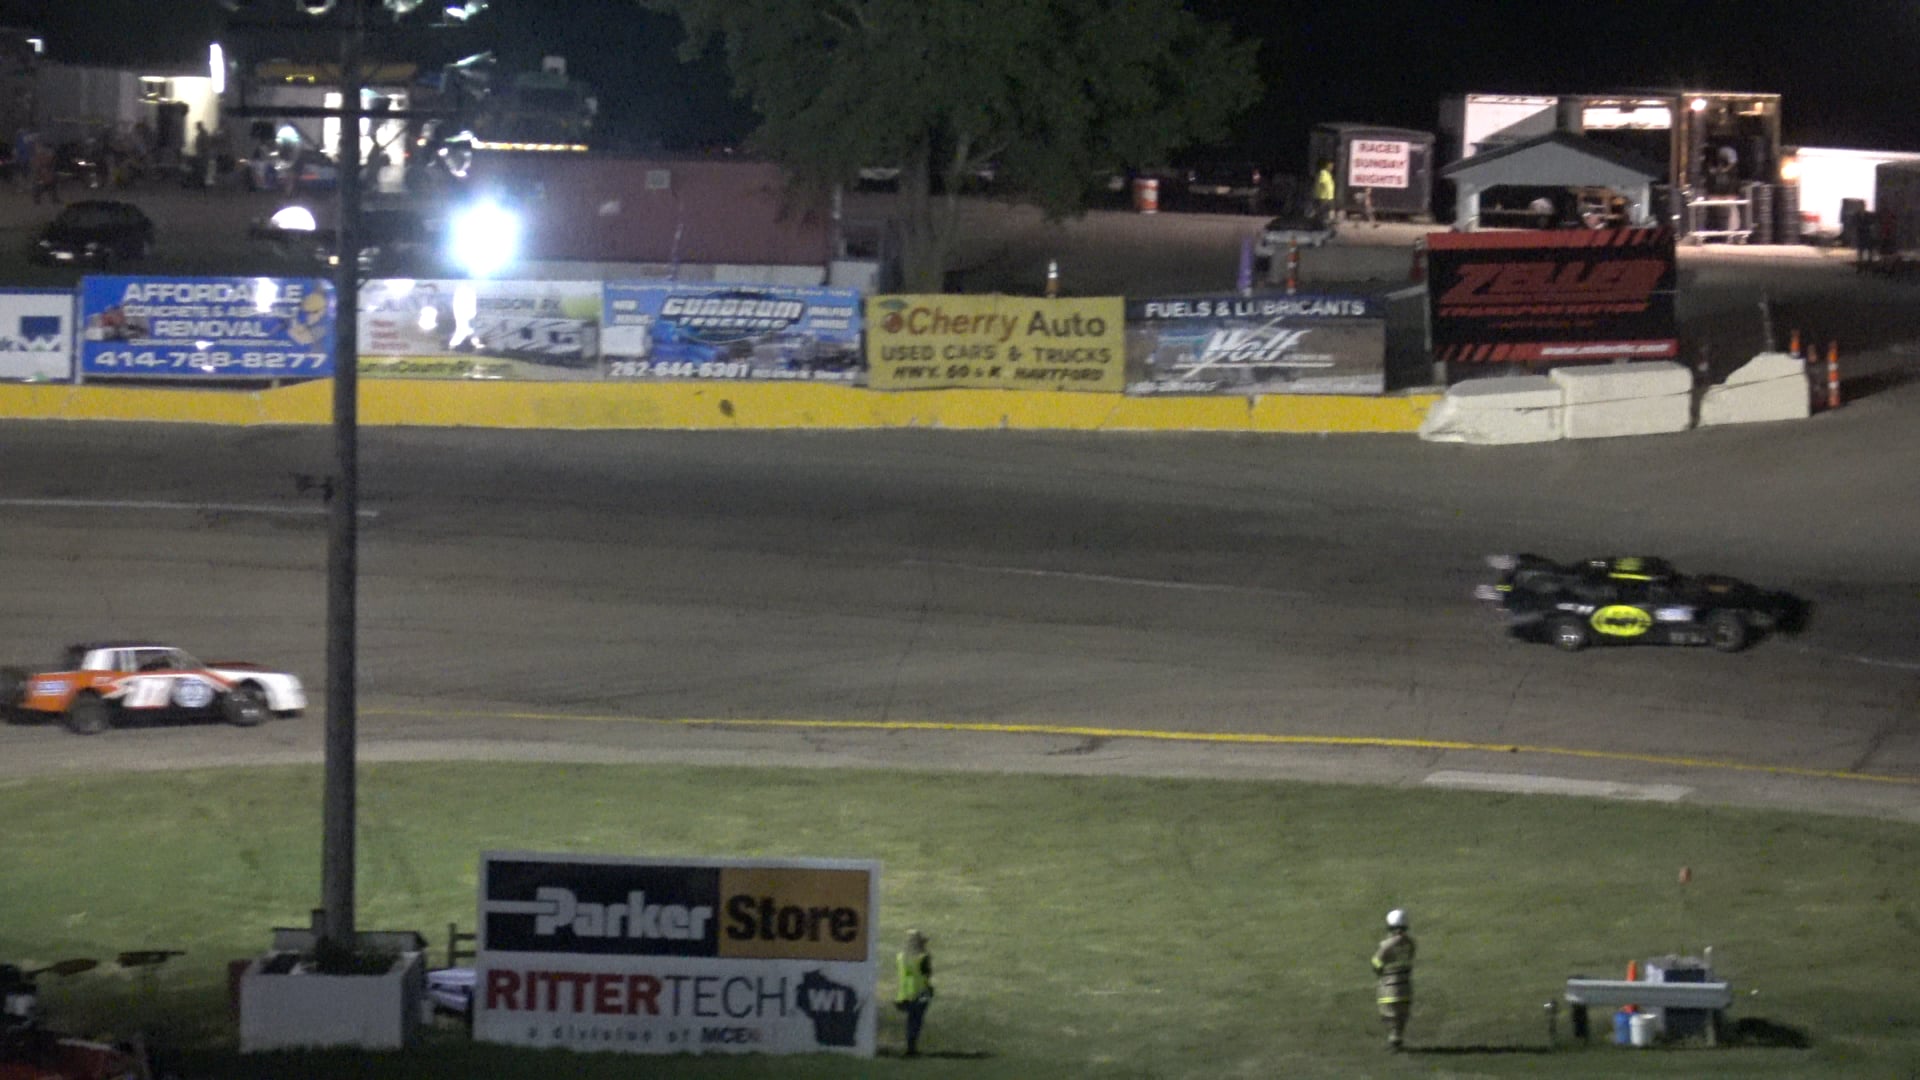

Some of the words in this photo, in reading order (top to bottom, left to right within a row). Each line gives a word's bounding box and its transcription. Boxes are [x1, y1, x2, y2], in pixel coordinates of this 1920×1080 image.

[1359, 143, 1402, 153] RACES
[1355, 158, 1407, 169] SUNDAY
[1355, 174, 1403, 185] NIGHTS
[123, 283, 302, 302] AFFORDALE
[123, 305, 209, 317] CONCRETE
[1144, 302, 1211, 318] FUELS
[1215, 302, 1230, 317] &
[1235, 301, 1366, 316] LUBRICANTS
[154, 321, 269, 338] REMOVAL
[908, 307, 1018, 343] Cherry
[1026, 310, 1106, 337] Auto
[882, 345, 936, 361] USED
[943, 345, 997, 361] CARS
[1008, 346, 1023, 361] &
[1033, 347, 1112, 364] TRUCKS
[535, 887, 714, 940] Parker
[725, 894, 858, 943] Store
[808, 988, 847, 1012] WI
[553, 1026, 651, 1044] division
